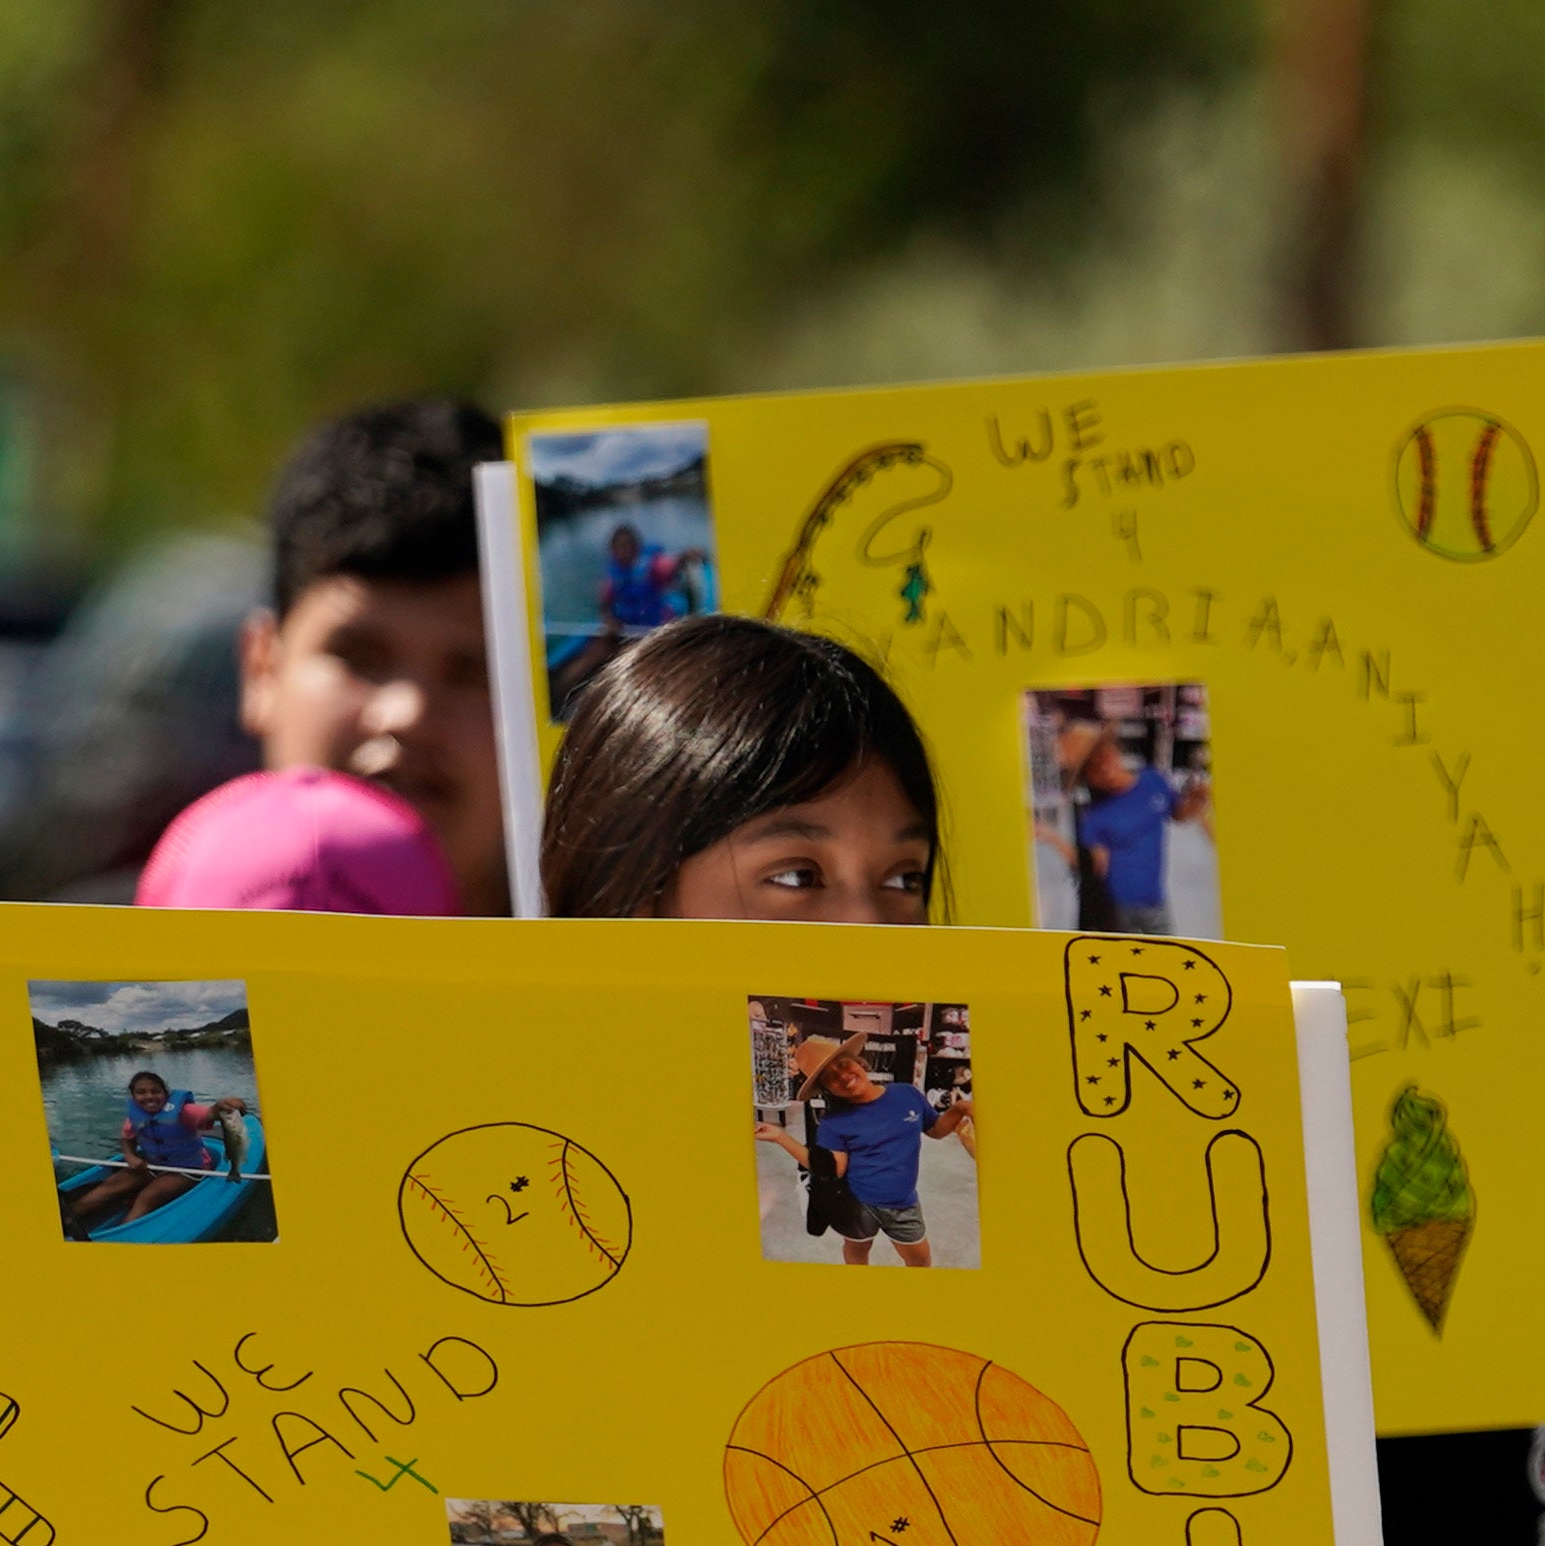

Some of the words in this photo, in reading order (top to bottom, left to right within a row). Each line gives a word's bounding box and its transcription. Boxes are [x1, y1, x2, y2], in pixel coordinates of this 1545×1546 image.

[985, 398, 1106, 468] WE
[1061, 439, 1196, 509] STAND
[1111, 508, 1142, 561] 4
[130, 1330, 315, 1438] WE
[356, 1455, 439, 1495] 4
